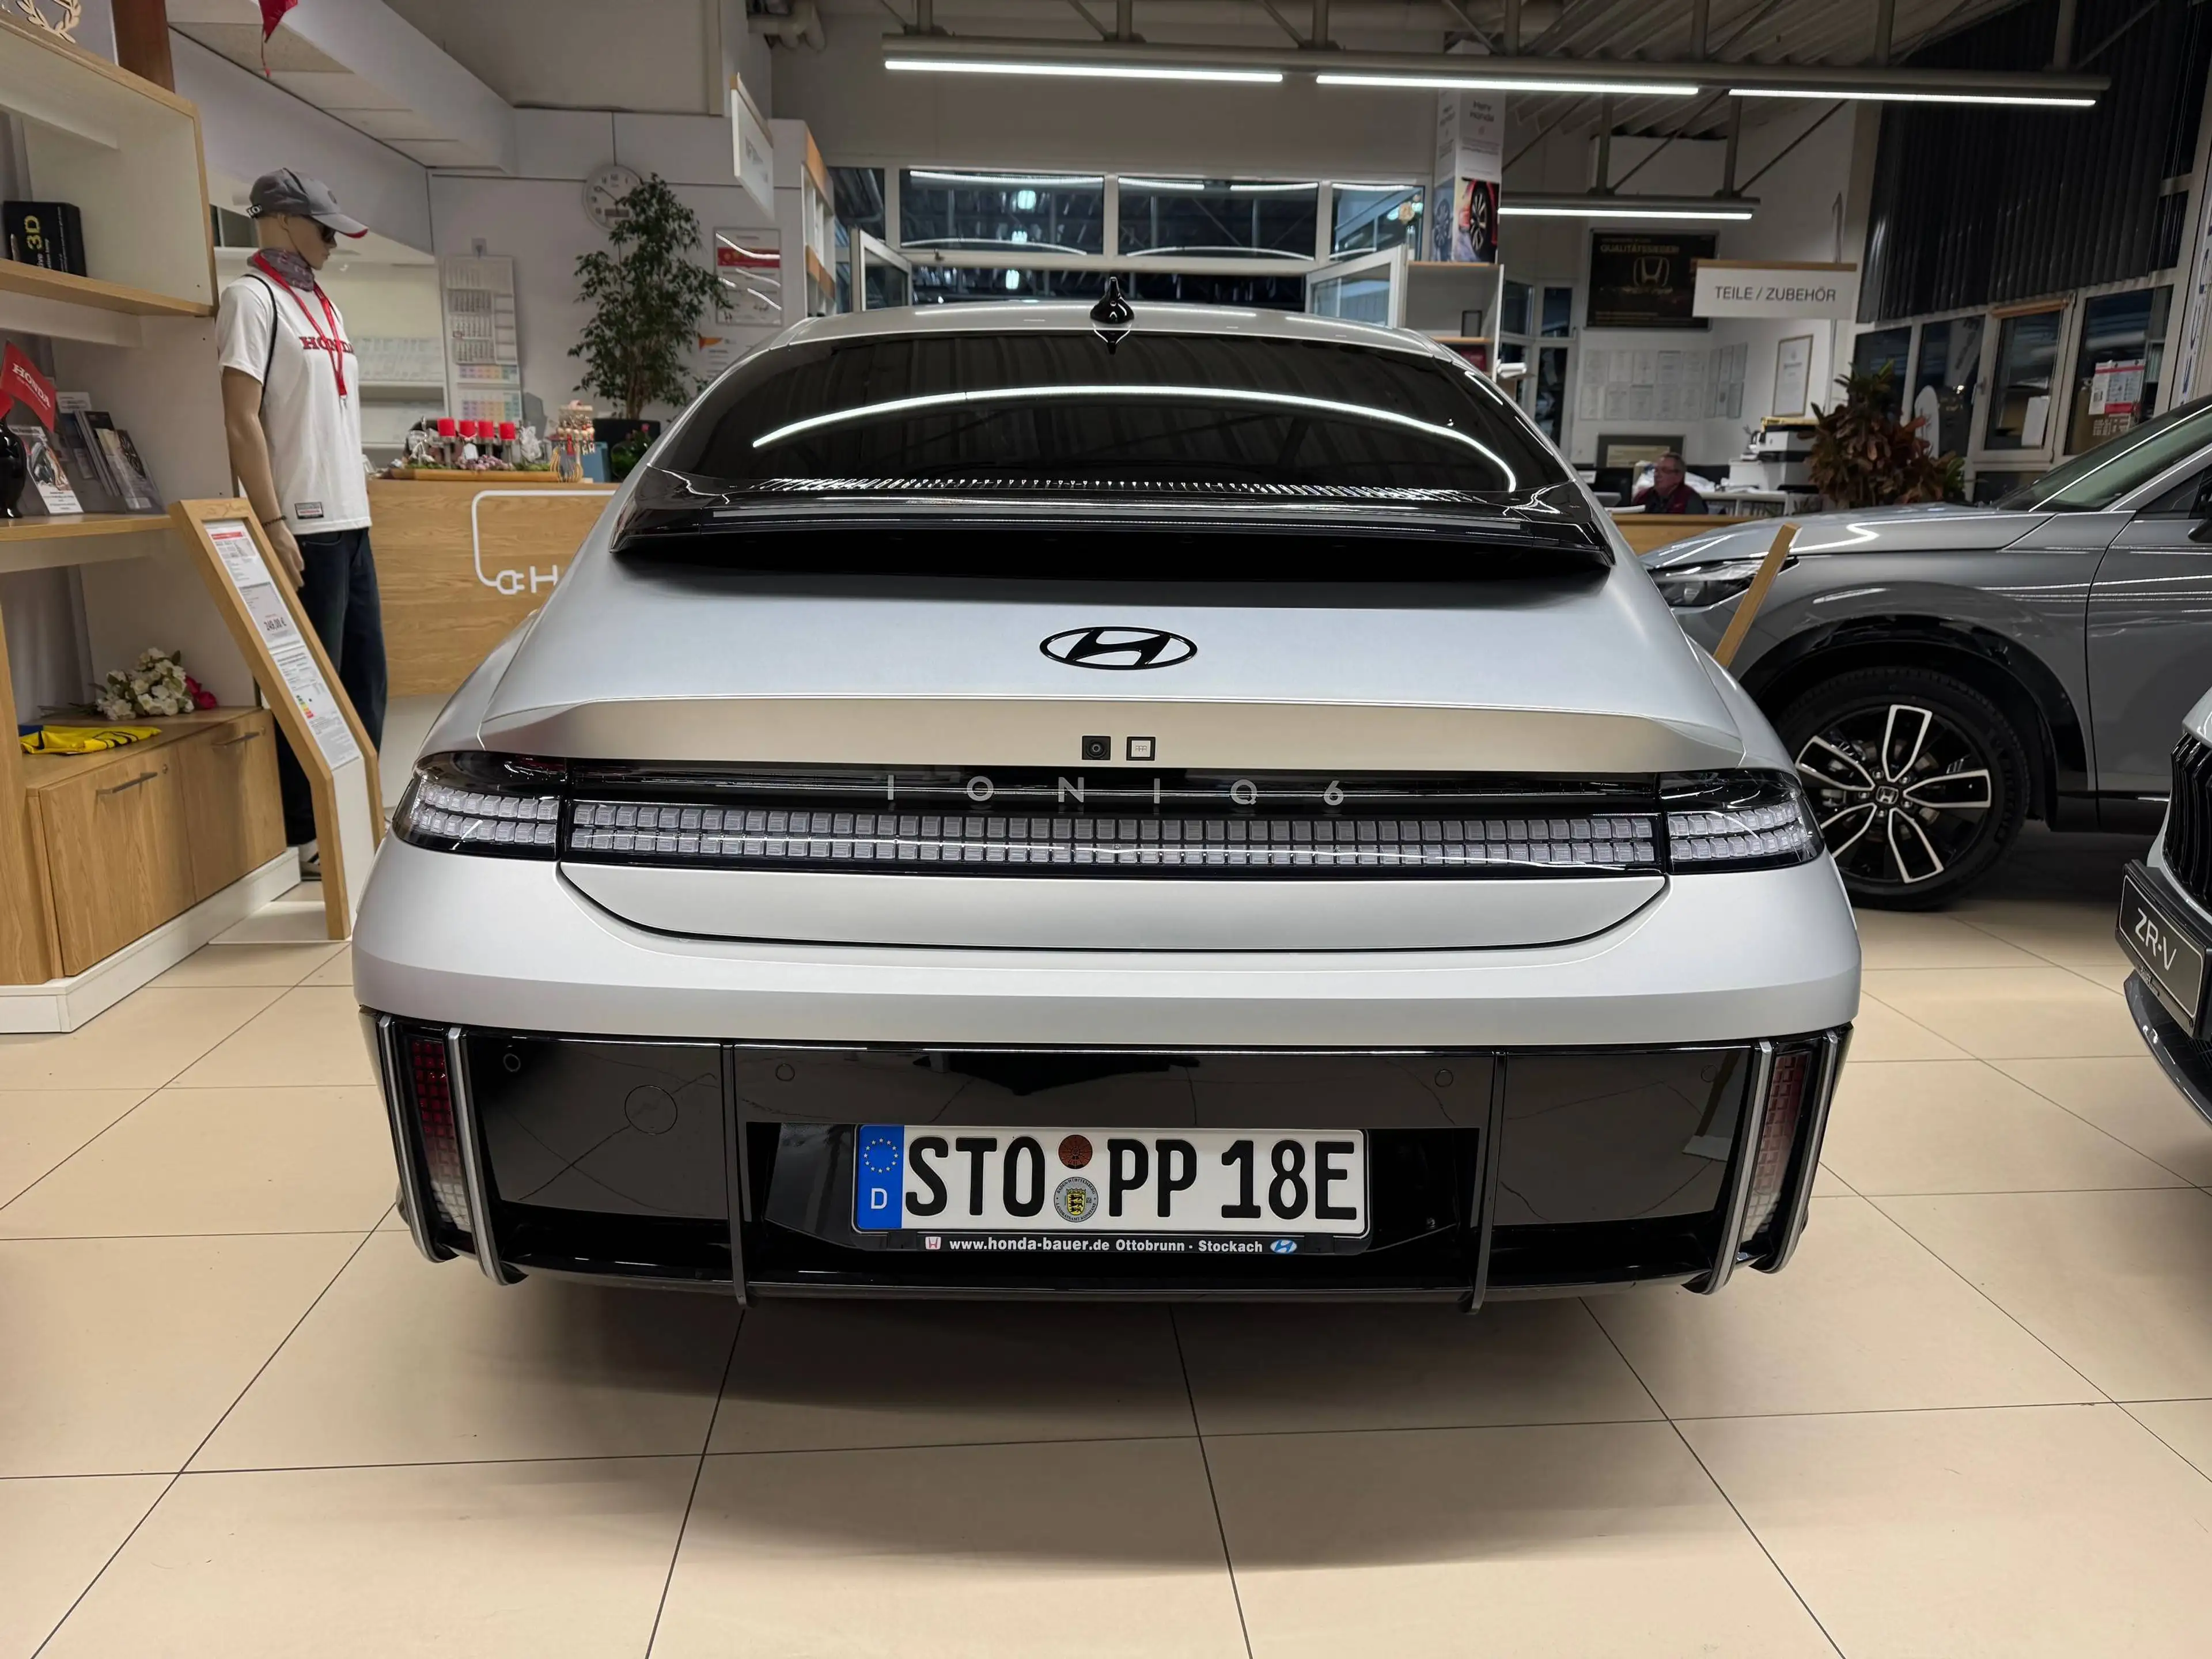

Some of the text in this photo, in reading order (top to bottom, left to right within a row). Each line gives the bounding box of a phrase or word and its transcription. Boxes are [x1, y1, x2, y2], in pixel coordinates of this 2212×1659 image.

[24, 215, 42, 250] 3D
[1715, 286, 1753, 300] TEILE
[1765, 286, 1836, 302] ZUBEHÖR
[12, 363, 51, 408] HONDA
[888, 775, 1344, 805] IONIQ 6
[2135, 907, 2177, 971] ZR-V
[906, 1136, 1046, 1217] STO
[1107, 1138, 1197, 1217] PP
[1221, 1139, 1357, 1220] 18E
[870, 1188, 888, 1209] D
[949, 1237, 1110, 1251] www.honda-bauer.de
[1116, 1239, 1185, 1251] Ottobrunn
[1198, 1240, 1263, 1252] Stockach
